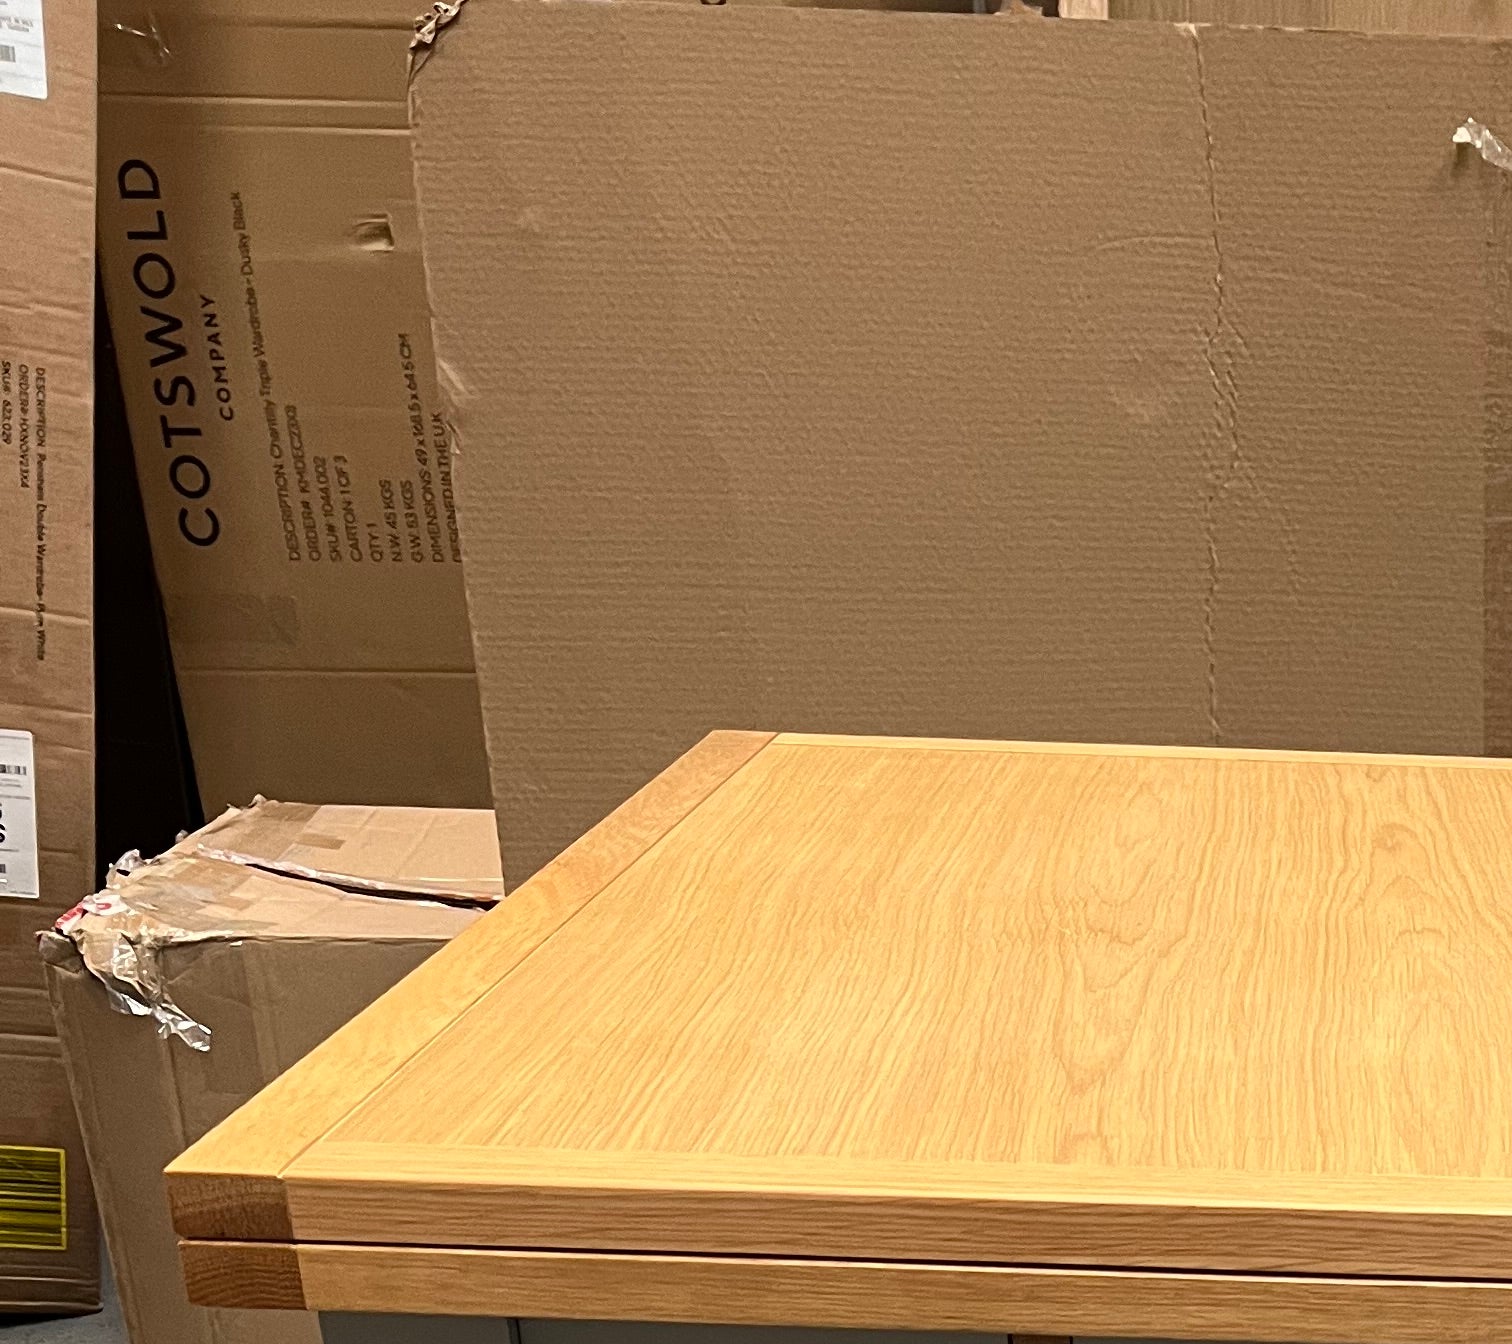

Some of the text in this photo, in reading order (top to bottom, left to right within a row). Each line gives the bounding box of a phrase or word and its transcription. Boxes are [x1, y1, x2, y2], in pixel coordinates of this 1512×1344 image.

[231, 192, 246, 230] Black
[118, 159, 220, 546] COTSWOLD
[200, 294, 234, 421] COMPANY
[433, 439, 449, 468] THE
[379, 480, 395, 509] KGS
[400, 480, 414, 510] KGS
